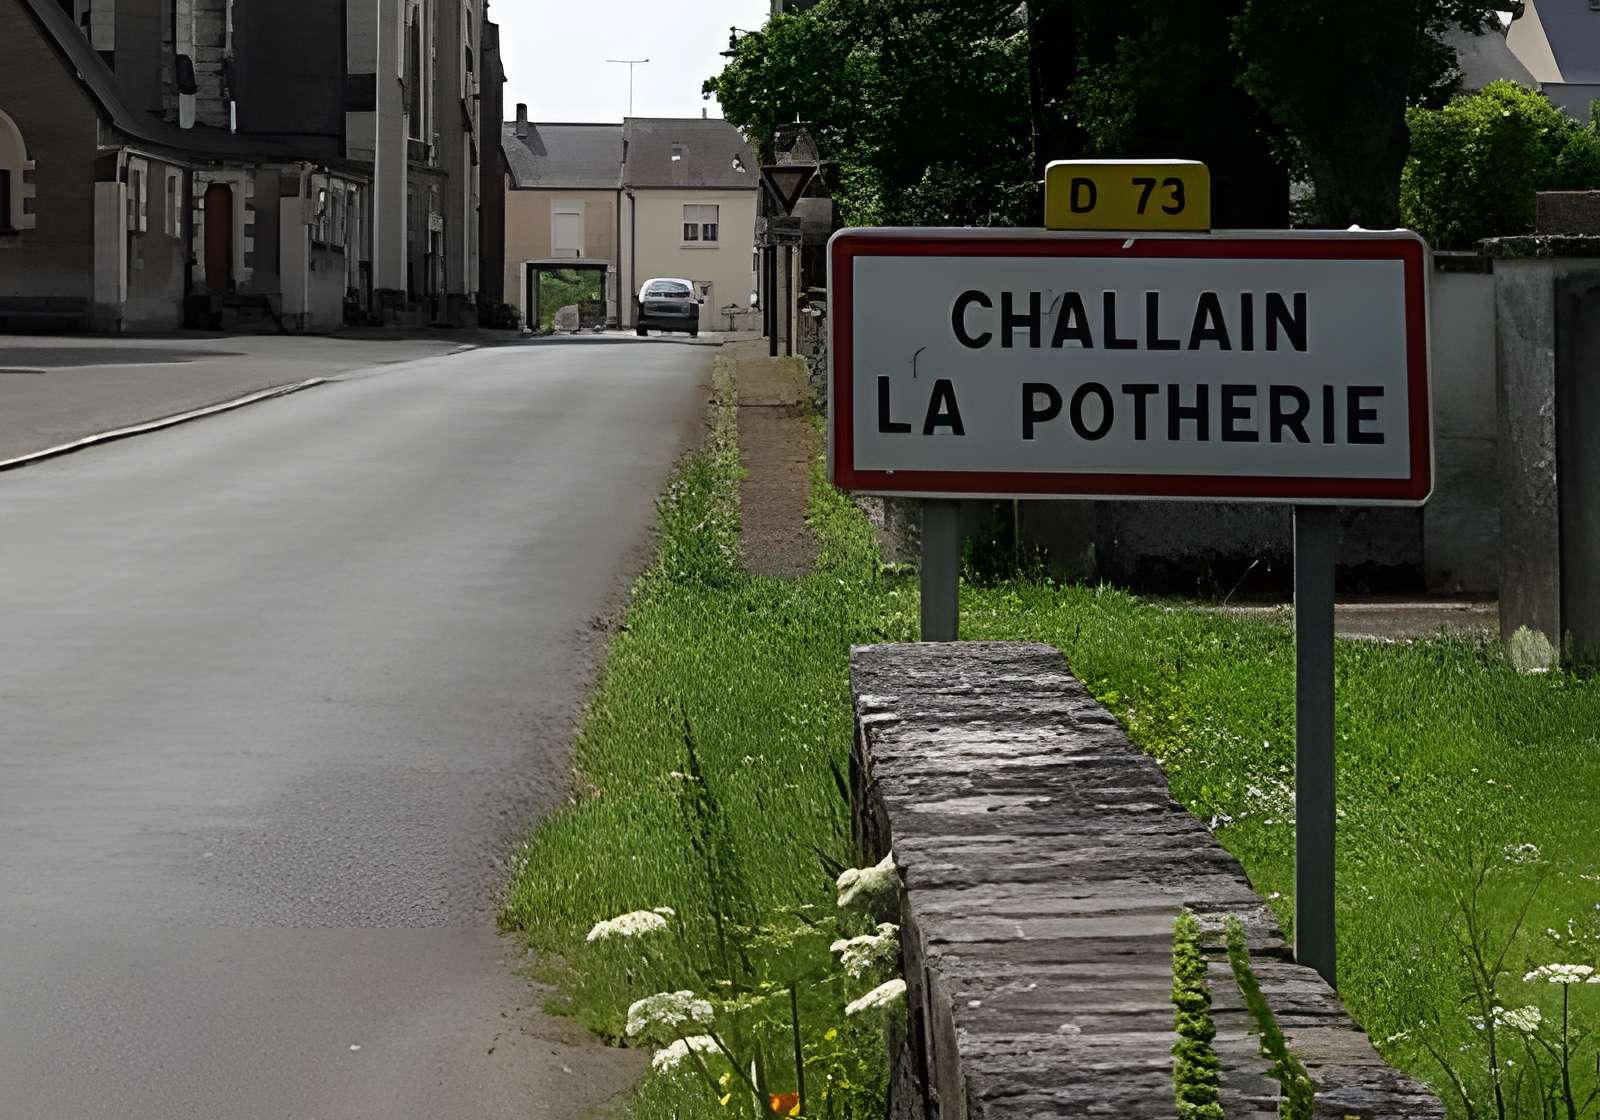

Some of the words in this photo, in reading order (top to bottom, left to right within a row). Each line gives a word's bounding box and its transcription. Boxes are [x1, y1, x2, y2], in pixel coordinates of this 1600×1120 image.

[1070, 178, 1097, 213] D
[1131, 177, 1186, 215] 73
[951, 289, 1308, 352] CHALLAIN
[876, 376, 966, 436] LA
[1021, 382, 1386, 445] POTHERIE
